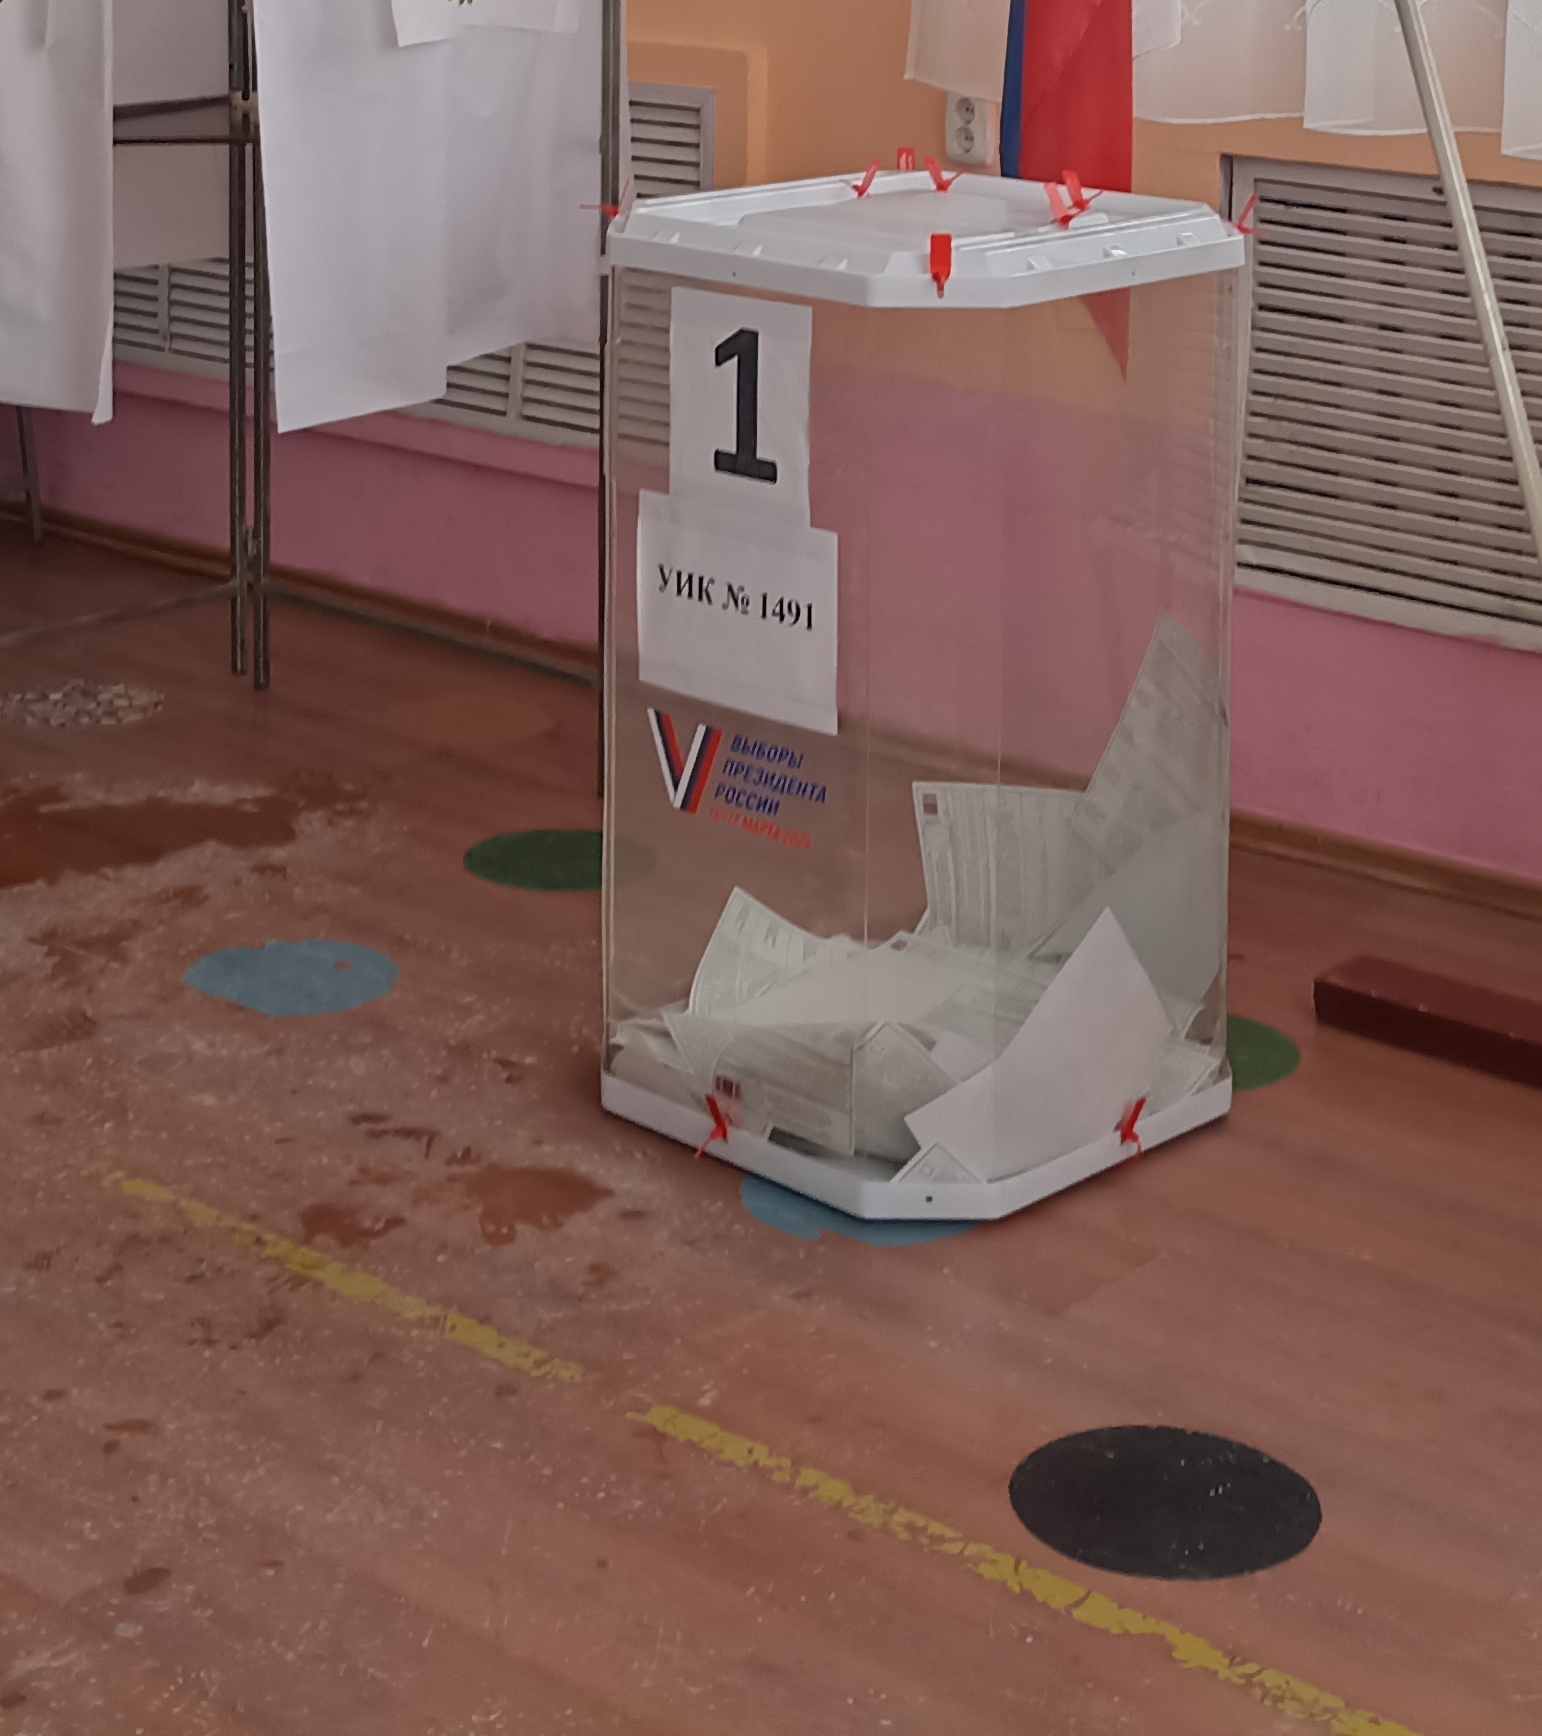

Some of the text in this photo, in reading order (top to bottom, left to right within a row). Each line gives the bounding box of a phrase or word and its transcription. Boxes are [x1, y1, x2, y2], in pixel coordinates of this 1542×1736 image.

[714, 327, 778, 485] 1
[658, 563, 813, 631] УИК № 1491
[731, 734, 804, 769] ВЫБОРЫ
[715, 781, 781, 817] РОССИИ
[723, 758, 827, 804] ПРЕЗИДЕНТА
